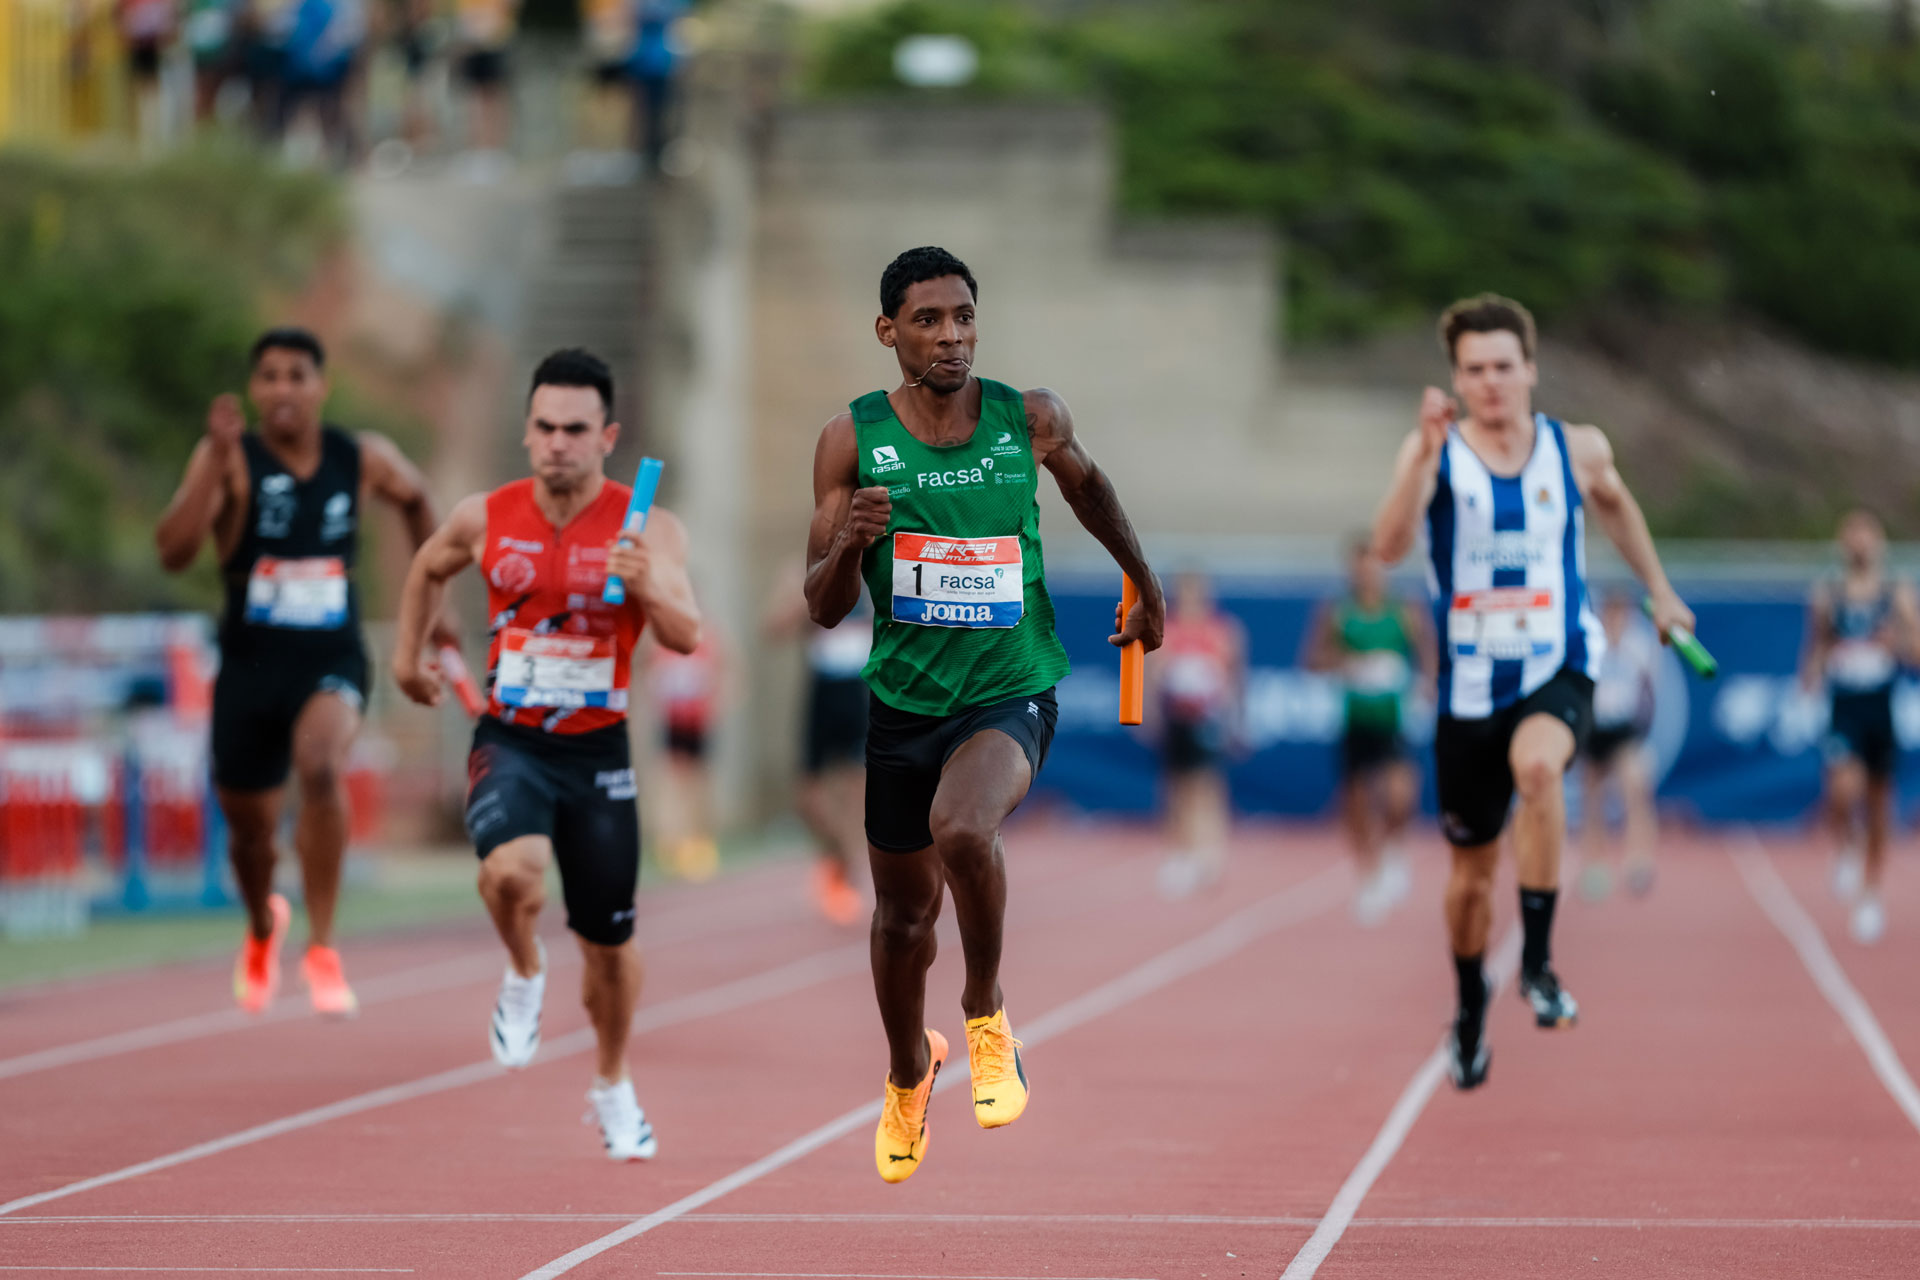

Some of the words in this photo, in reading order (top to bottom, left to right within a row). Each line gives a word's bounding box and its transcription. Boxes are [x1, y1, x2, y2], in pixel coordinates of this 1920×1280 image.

[872, 461, 906, 473] rasán
[917, 467, 984, 488] Facsa
[912, 563, 922, 596] 1
[940, 575, 995, 589] Facsa
[920, 602, 993, 622] Joma
[523, 655, 536, 686] 3
